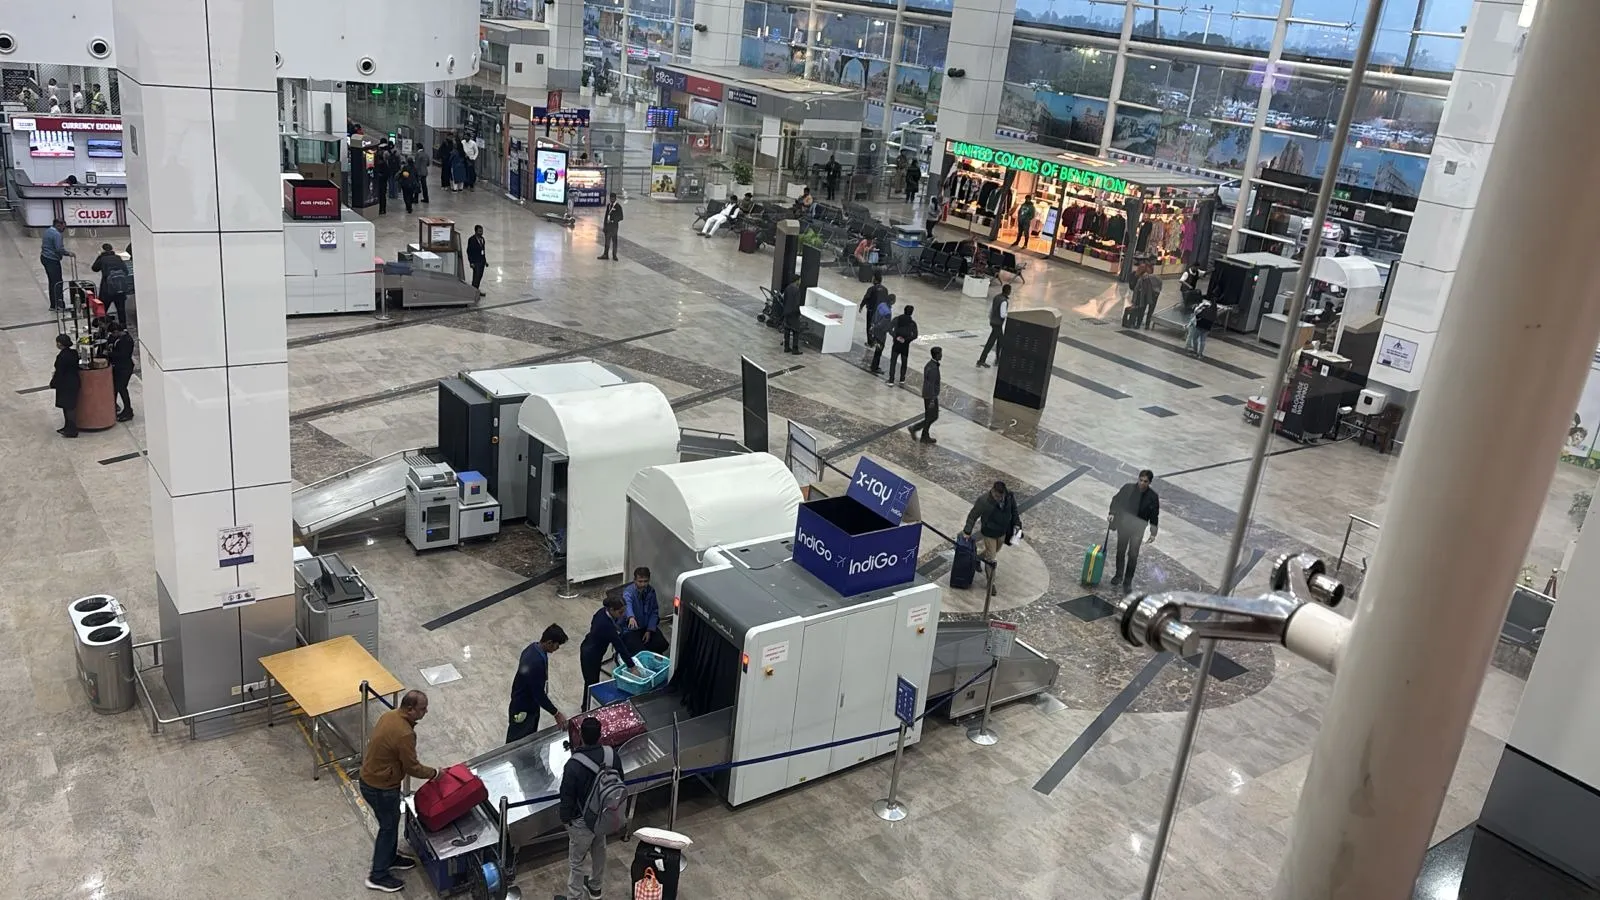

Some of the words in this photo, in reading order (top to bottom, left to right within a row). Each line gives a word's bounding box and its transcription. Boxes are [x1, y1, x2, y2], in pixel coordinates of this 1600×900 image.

[61, 122, 95, 130] CURRENCY
[954, 142, 993, 162] UNITED
[994, 151, 1039, 174] COLORS
[1041, 161, 1058, 178] OF
[1060, 167, 1128, 194] BENETTON
[78, 210, 113, 219] CLUB7
[1291, 381, 1304, 413] BAGGAGE
[1296, 383, 1309, 415] WRAPPING
[856, 471, 892, 506] x-ray
[890, 507, 903, 518] IndiGo
[798, 527, 832, 561] IndiGo
[849, 552, 898, 575] IndiGo
